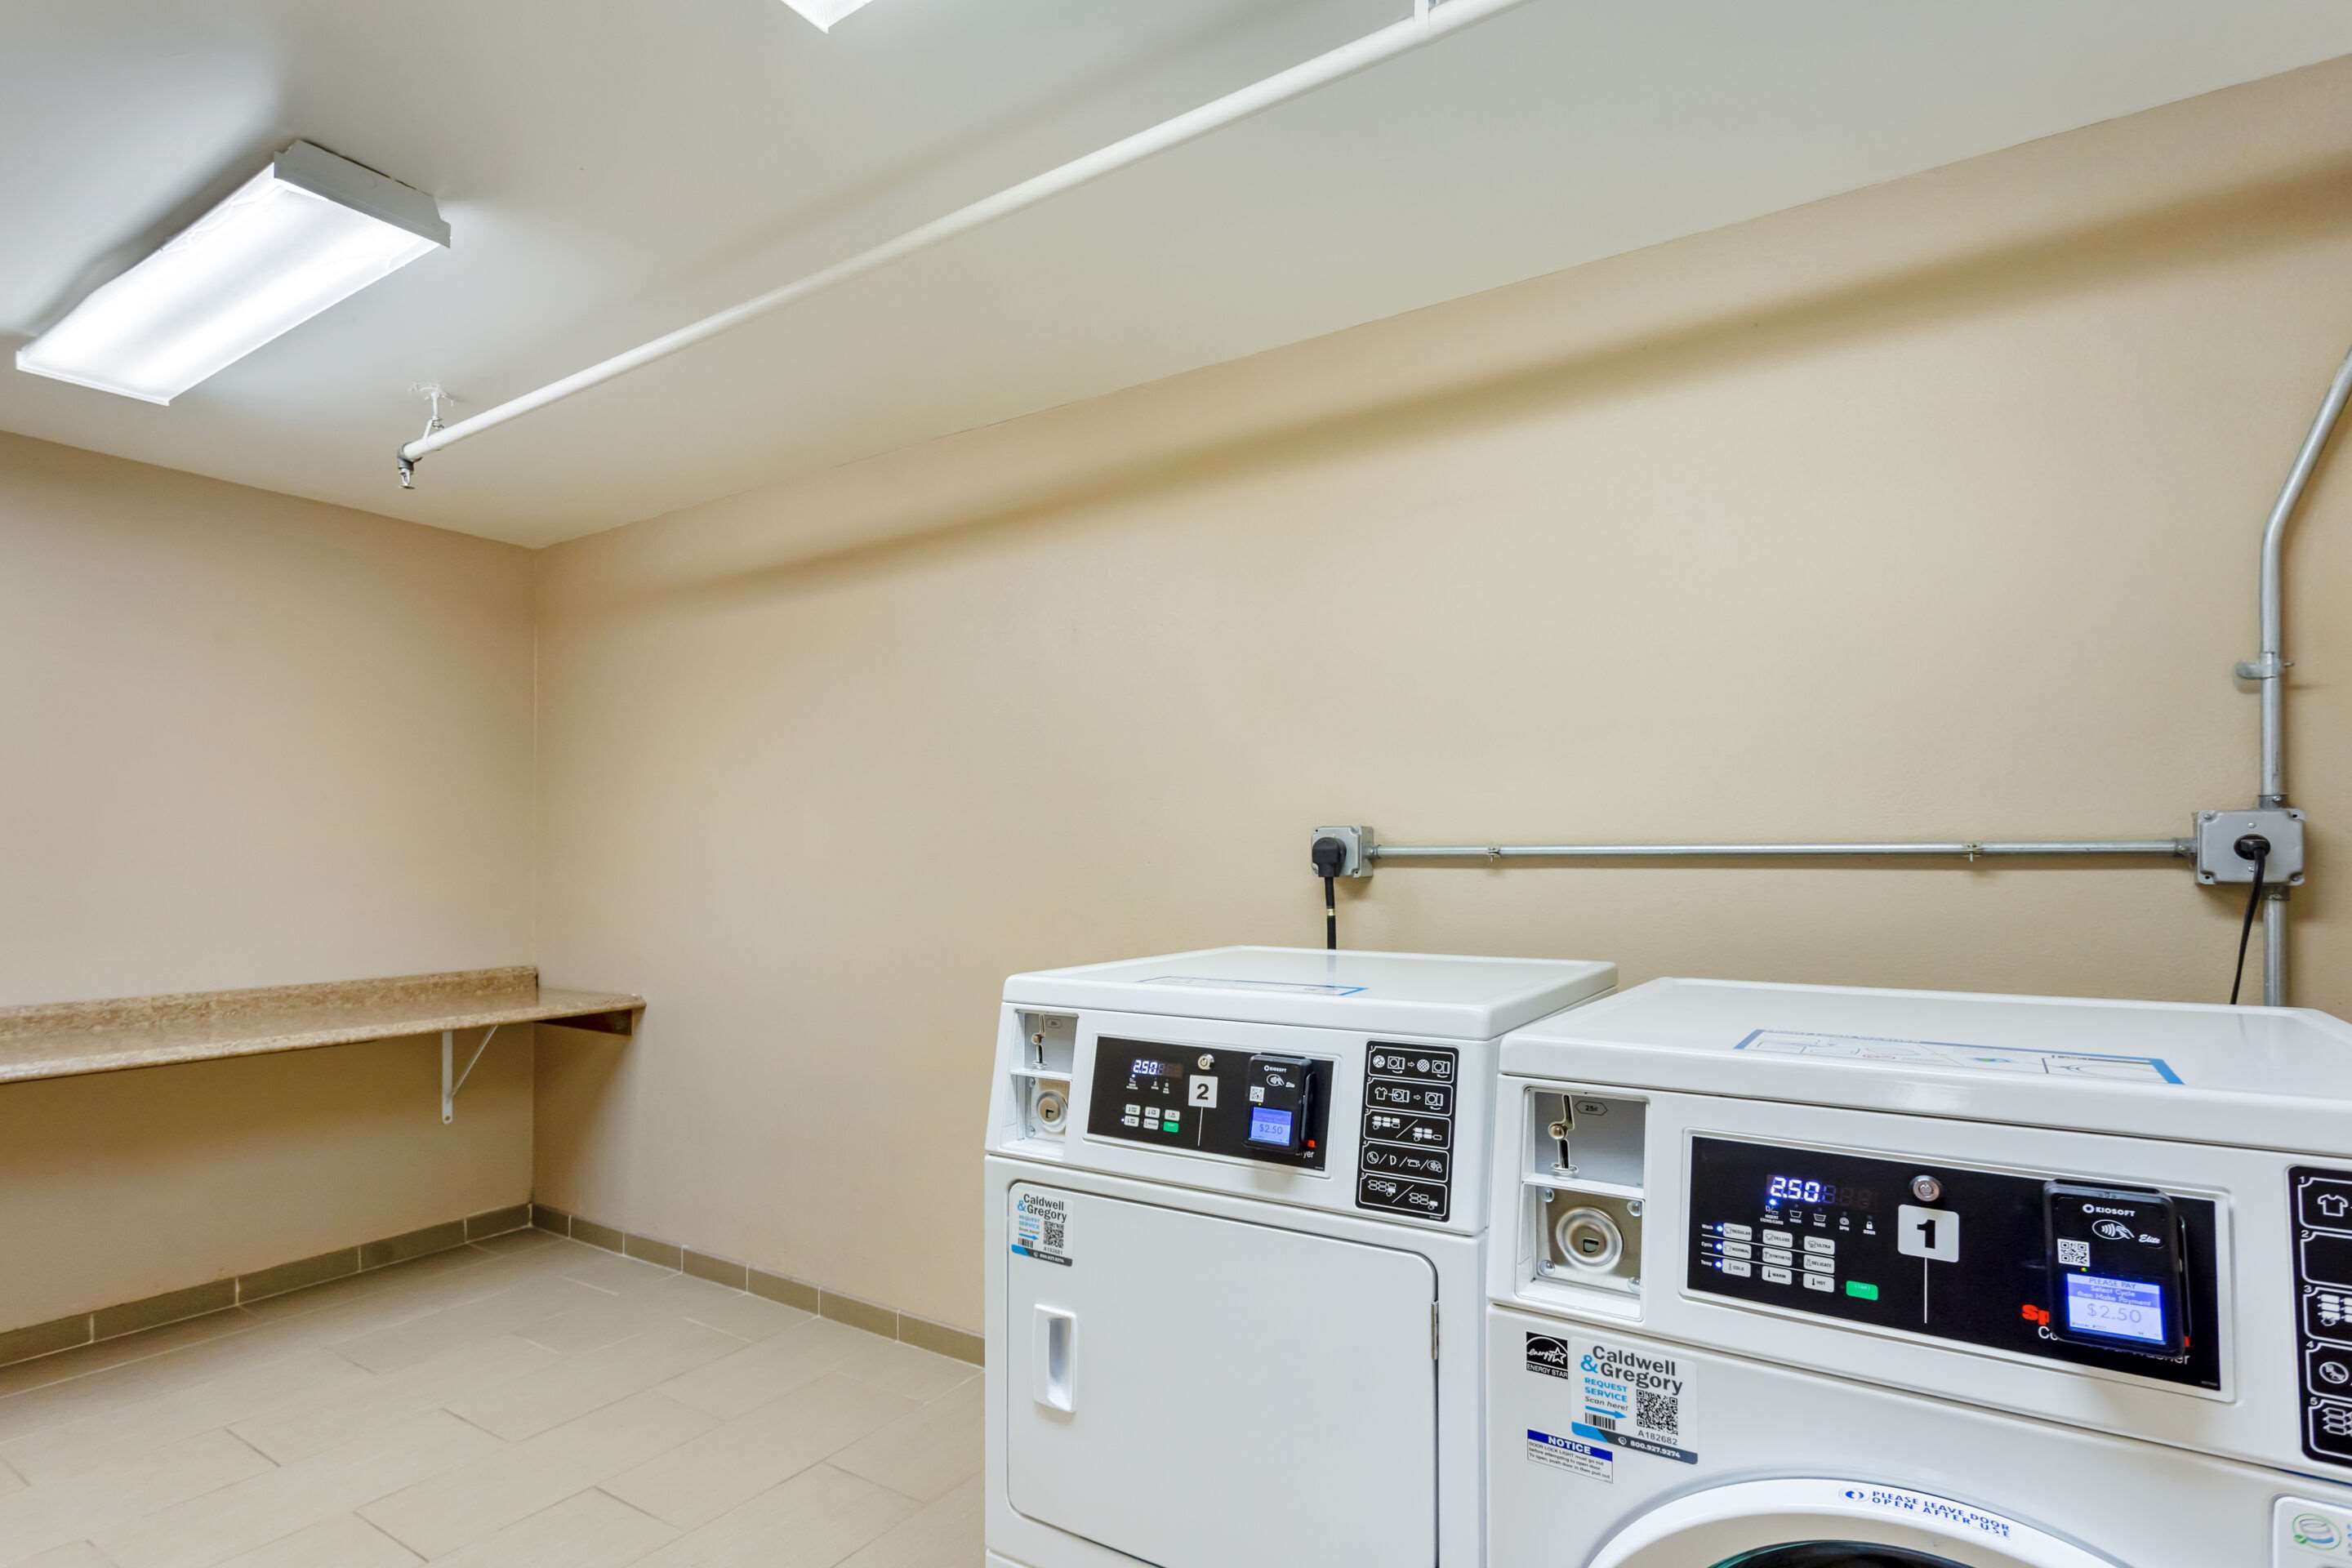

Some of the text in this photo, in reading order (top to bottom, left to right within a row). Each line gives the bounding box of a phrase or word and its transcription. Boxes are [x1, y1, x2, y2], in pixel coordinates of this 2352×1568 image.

[1133, 1059, 1158, 1075] 2.50
[1196, 1083, 1209, 1100] 2
[1258, 1124, 1283, 1134] $2.50
[1770, 1176, 1820, 1202] 2.50
[1023, 1193, 1064, 1211] Caldwell
[1018, 1199, 1067, 1223] & Gregory
[2096, 1207, 2136, 1217] KIOSOFT
[1917, 1218, 1936, 1250] 1
[2138, 1234, 2161, 1244] Elite
[2089, 1277, 2118, 1287] PLEASE
[2304, 1285, 2312, 1293] 3
[2091, 1285, 2136, 1298] Select Cycle
[2095, 1293, 2117, 1302] Make
[2118, 1296, 2151, 1307] Payment
[2087, 1303, 2142, 1323] $2.50
[2306, 1340, 2314, 1348] 4
[1592, 1345, 1676, 1376] Caldwell
[1527, 1363, 1569, 1379] ENERGY STAR
[1580, 1354, 1683, 1396] & Gregory
[1584, 1377, 1628, 1392] REQUEST
[1584, 1387, 1628, 1402] SERVICE
[2310, 1397, 2318, 1405] 5
[1584, 1396, 1628, 1411] Scan here!
[1548, 1436, 1592, 1454] NOTICE
[1637, 1430, 1678, 1446] A182682
[1872, 1497, 2011, 1538] OPEN AFTER USE
[1873, 1490, 2010, 1530] PLEASE LEAVE DOOR
